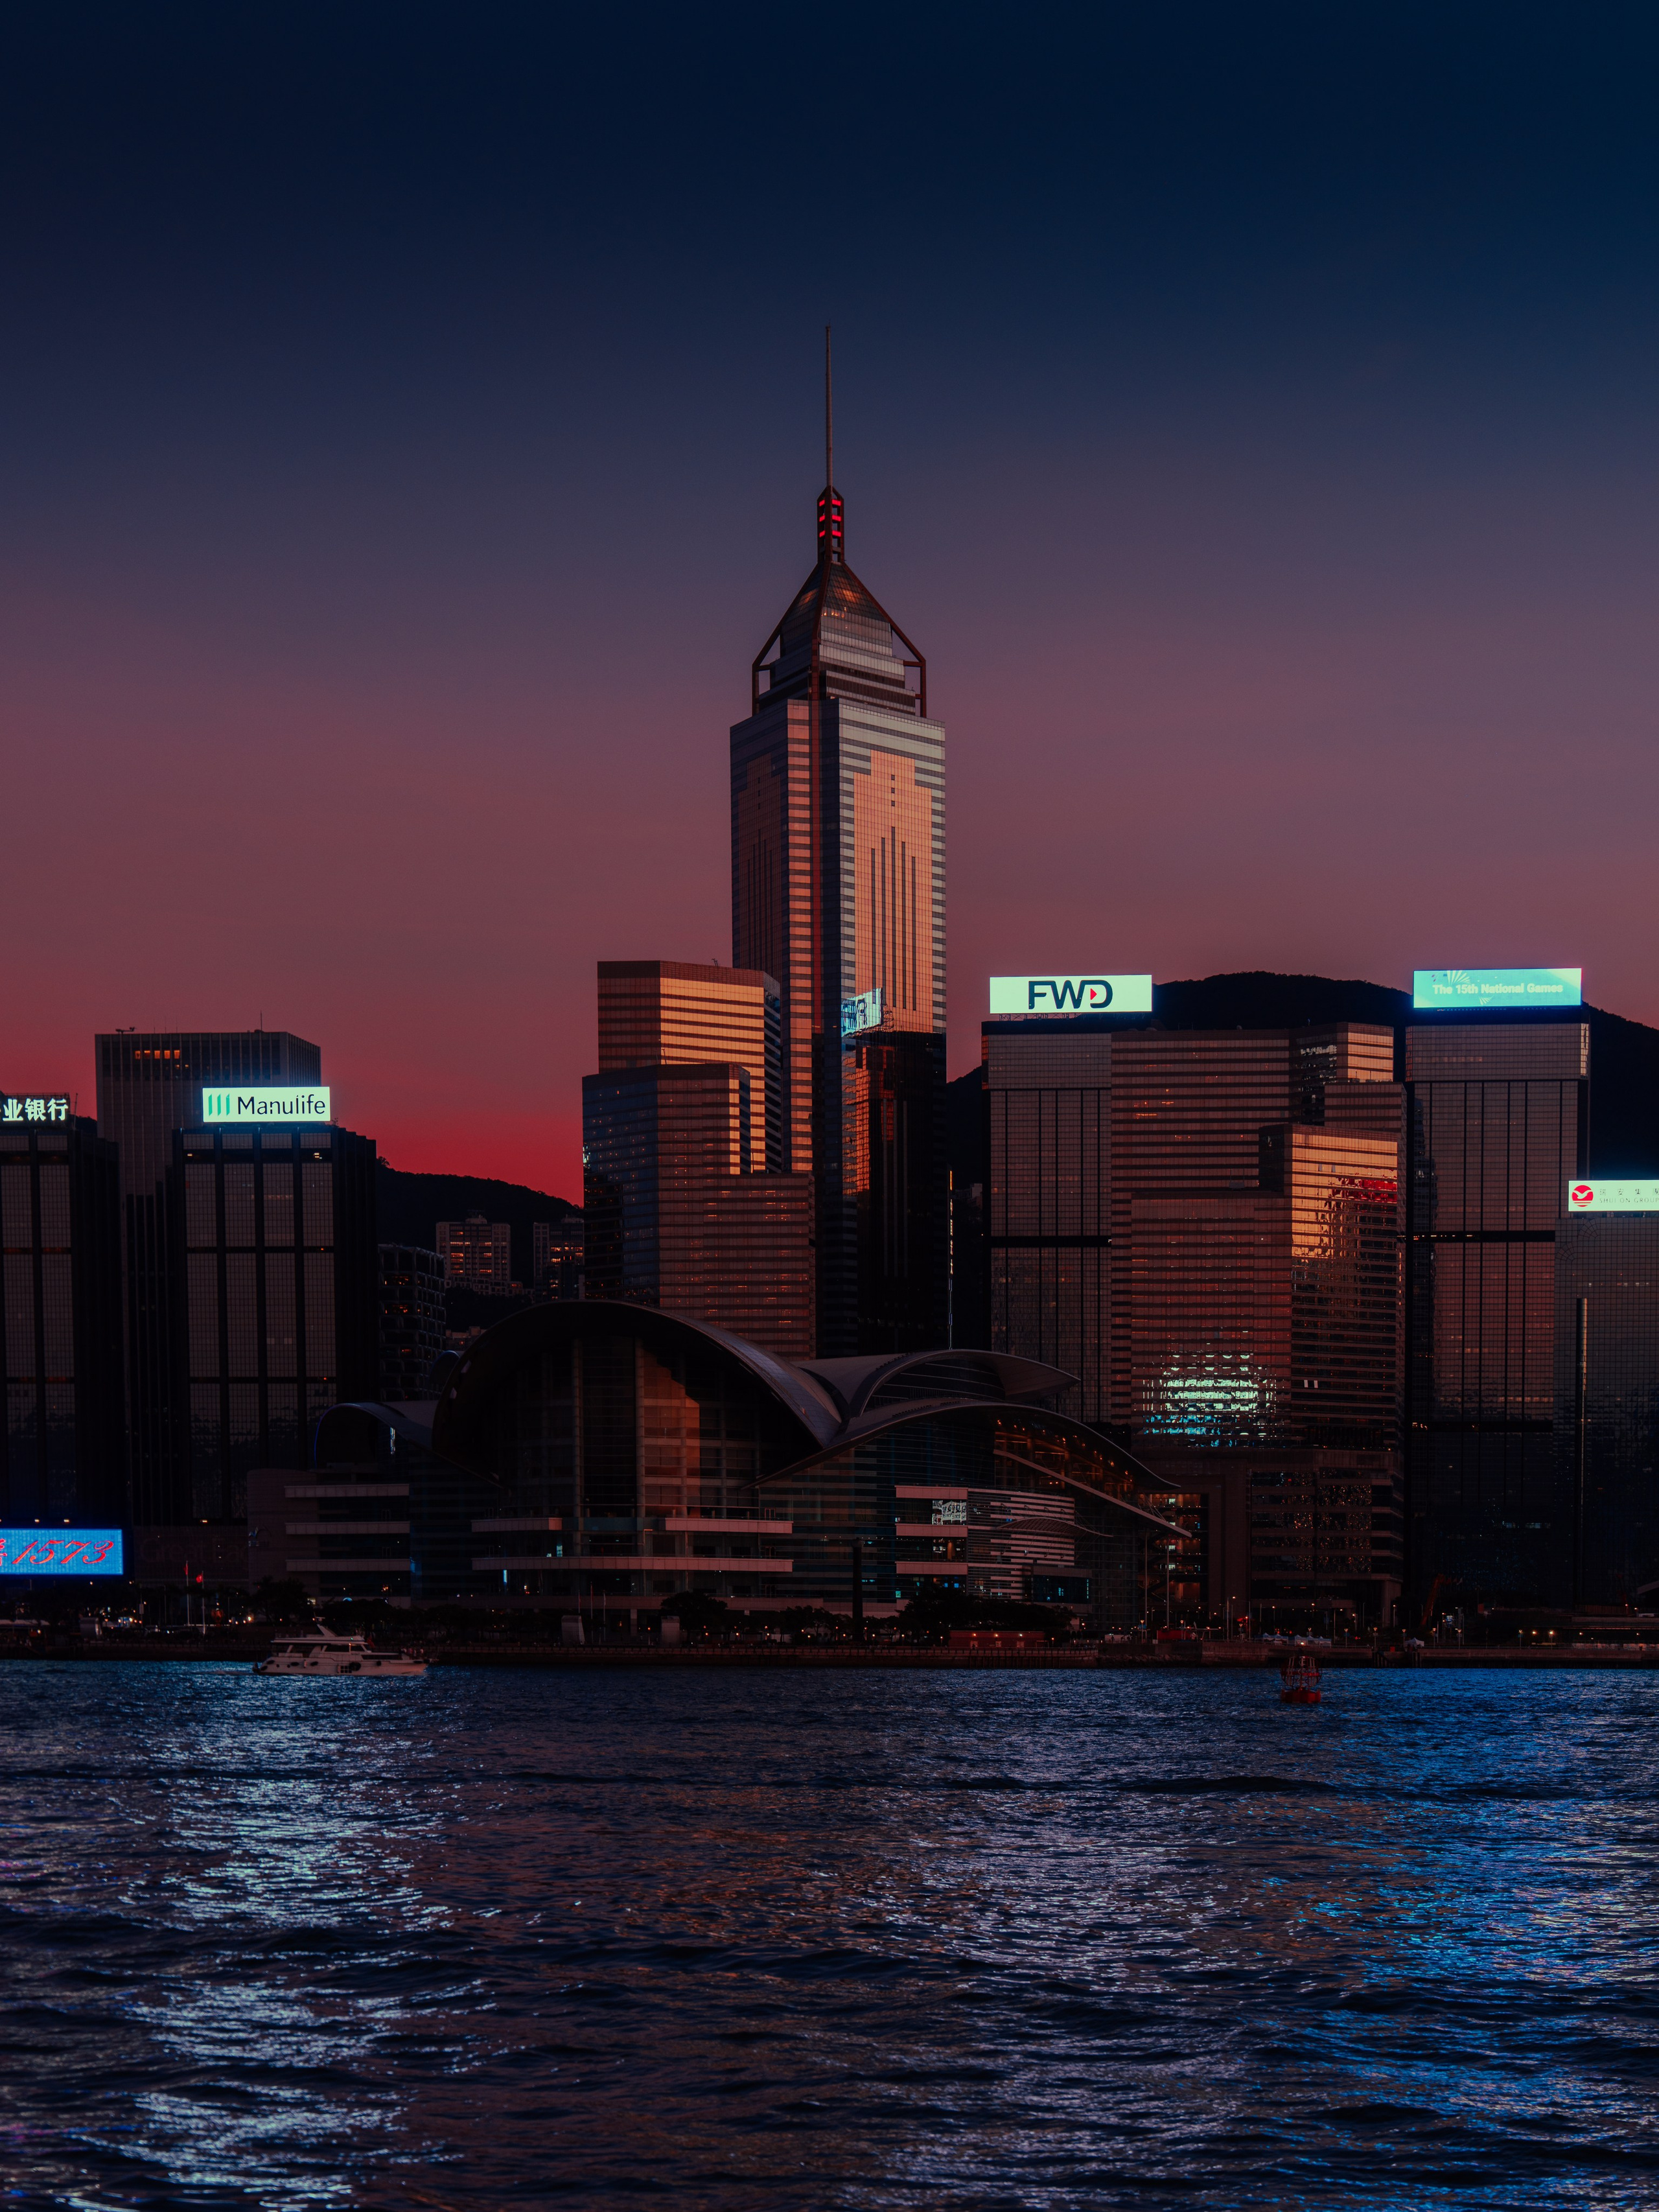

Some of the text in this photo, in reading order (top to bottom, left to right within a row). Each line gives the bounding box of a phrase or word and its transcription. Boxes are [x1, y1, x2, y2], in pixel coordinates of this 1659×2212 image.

[1028, 979, 1113, 1010] FWD
[1432, 983, 1564, 994] The 15th National Games
[0, 1098, 69, 1121] 业银行
[238, 1093, 326, 1115] Manulife
[12, 1539, 114, 1565] 1573
[140, 1537, 207, 1563] Great
